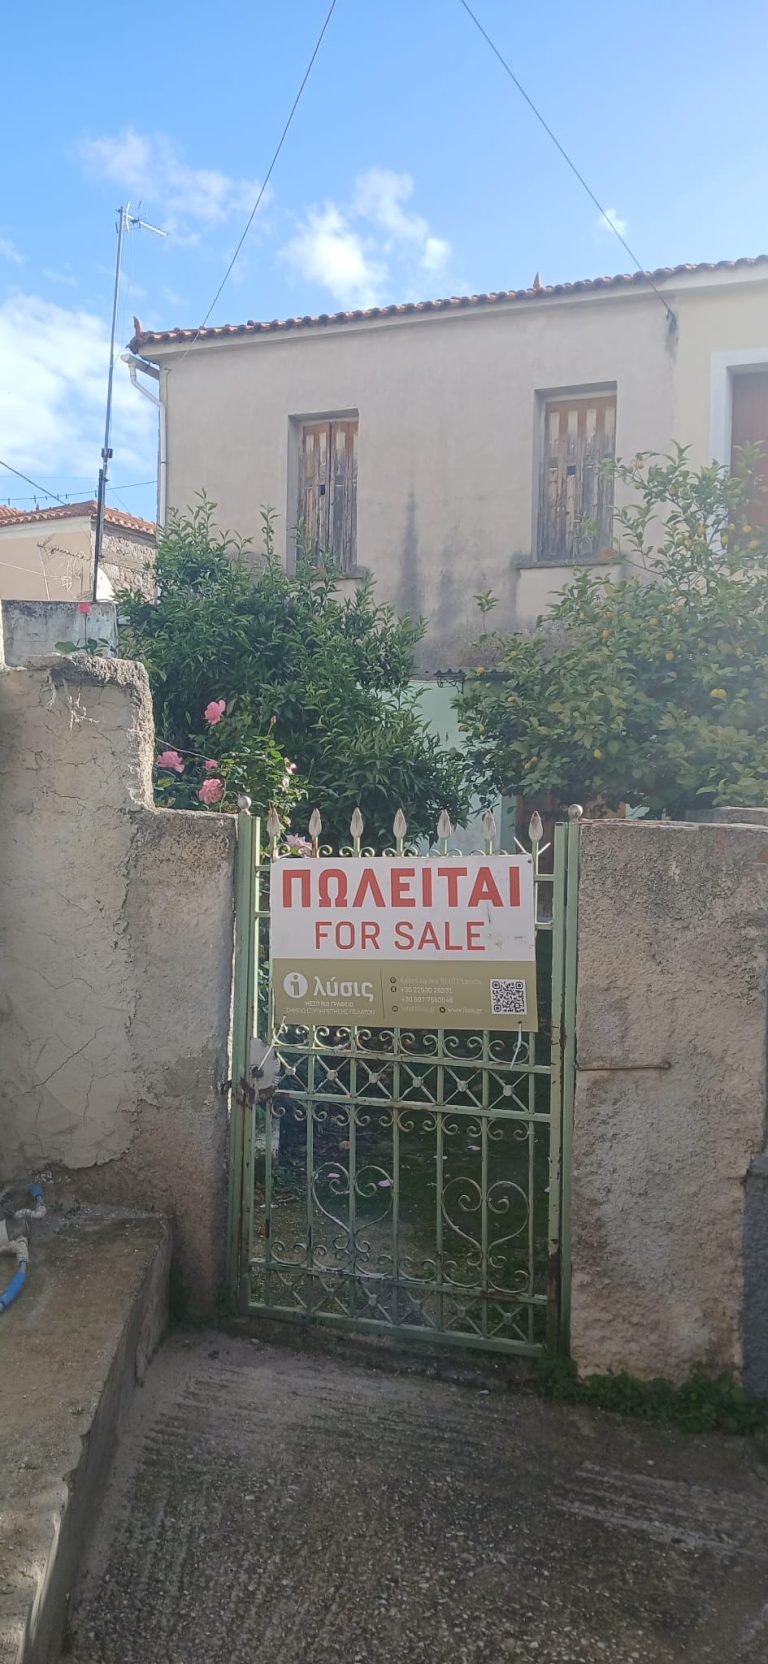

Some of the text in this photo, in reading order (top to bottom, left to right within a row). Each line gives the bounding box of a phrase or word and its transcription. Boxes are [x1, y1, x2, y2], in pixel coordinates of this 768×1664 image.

[282, 866, 521, 908] ΠΩΛΕΙΤΑΙ
[315, 921, 486, 951] FOR SALE
[313, 975, 374, 1002] λύσις
